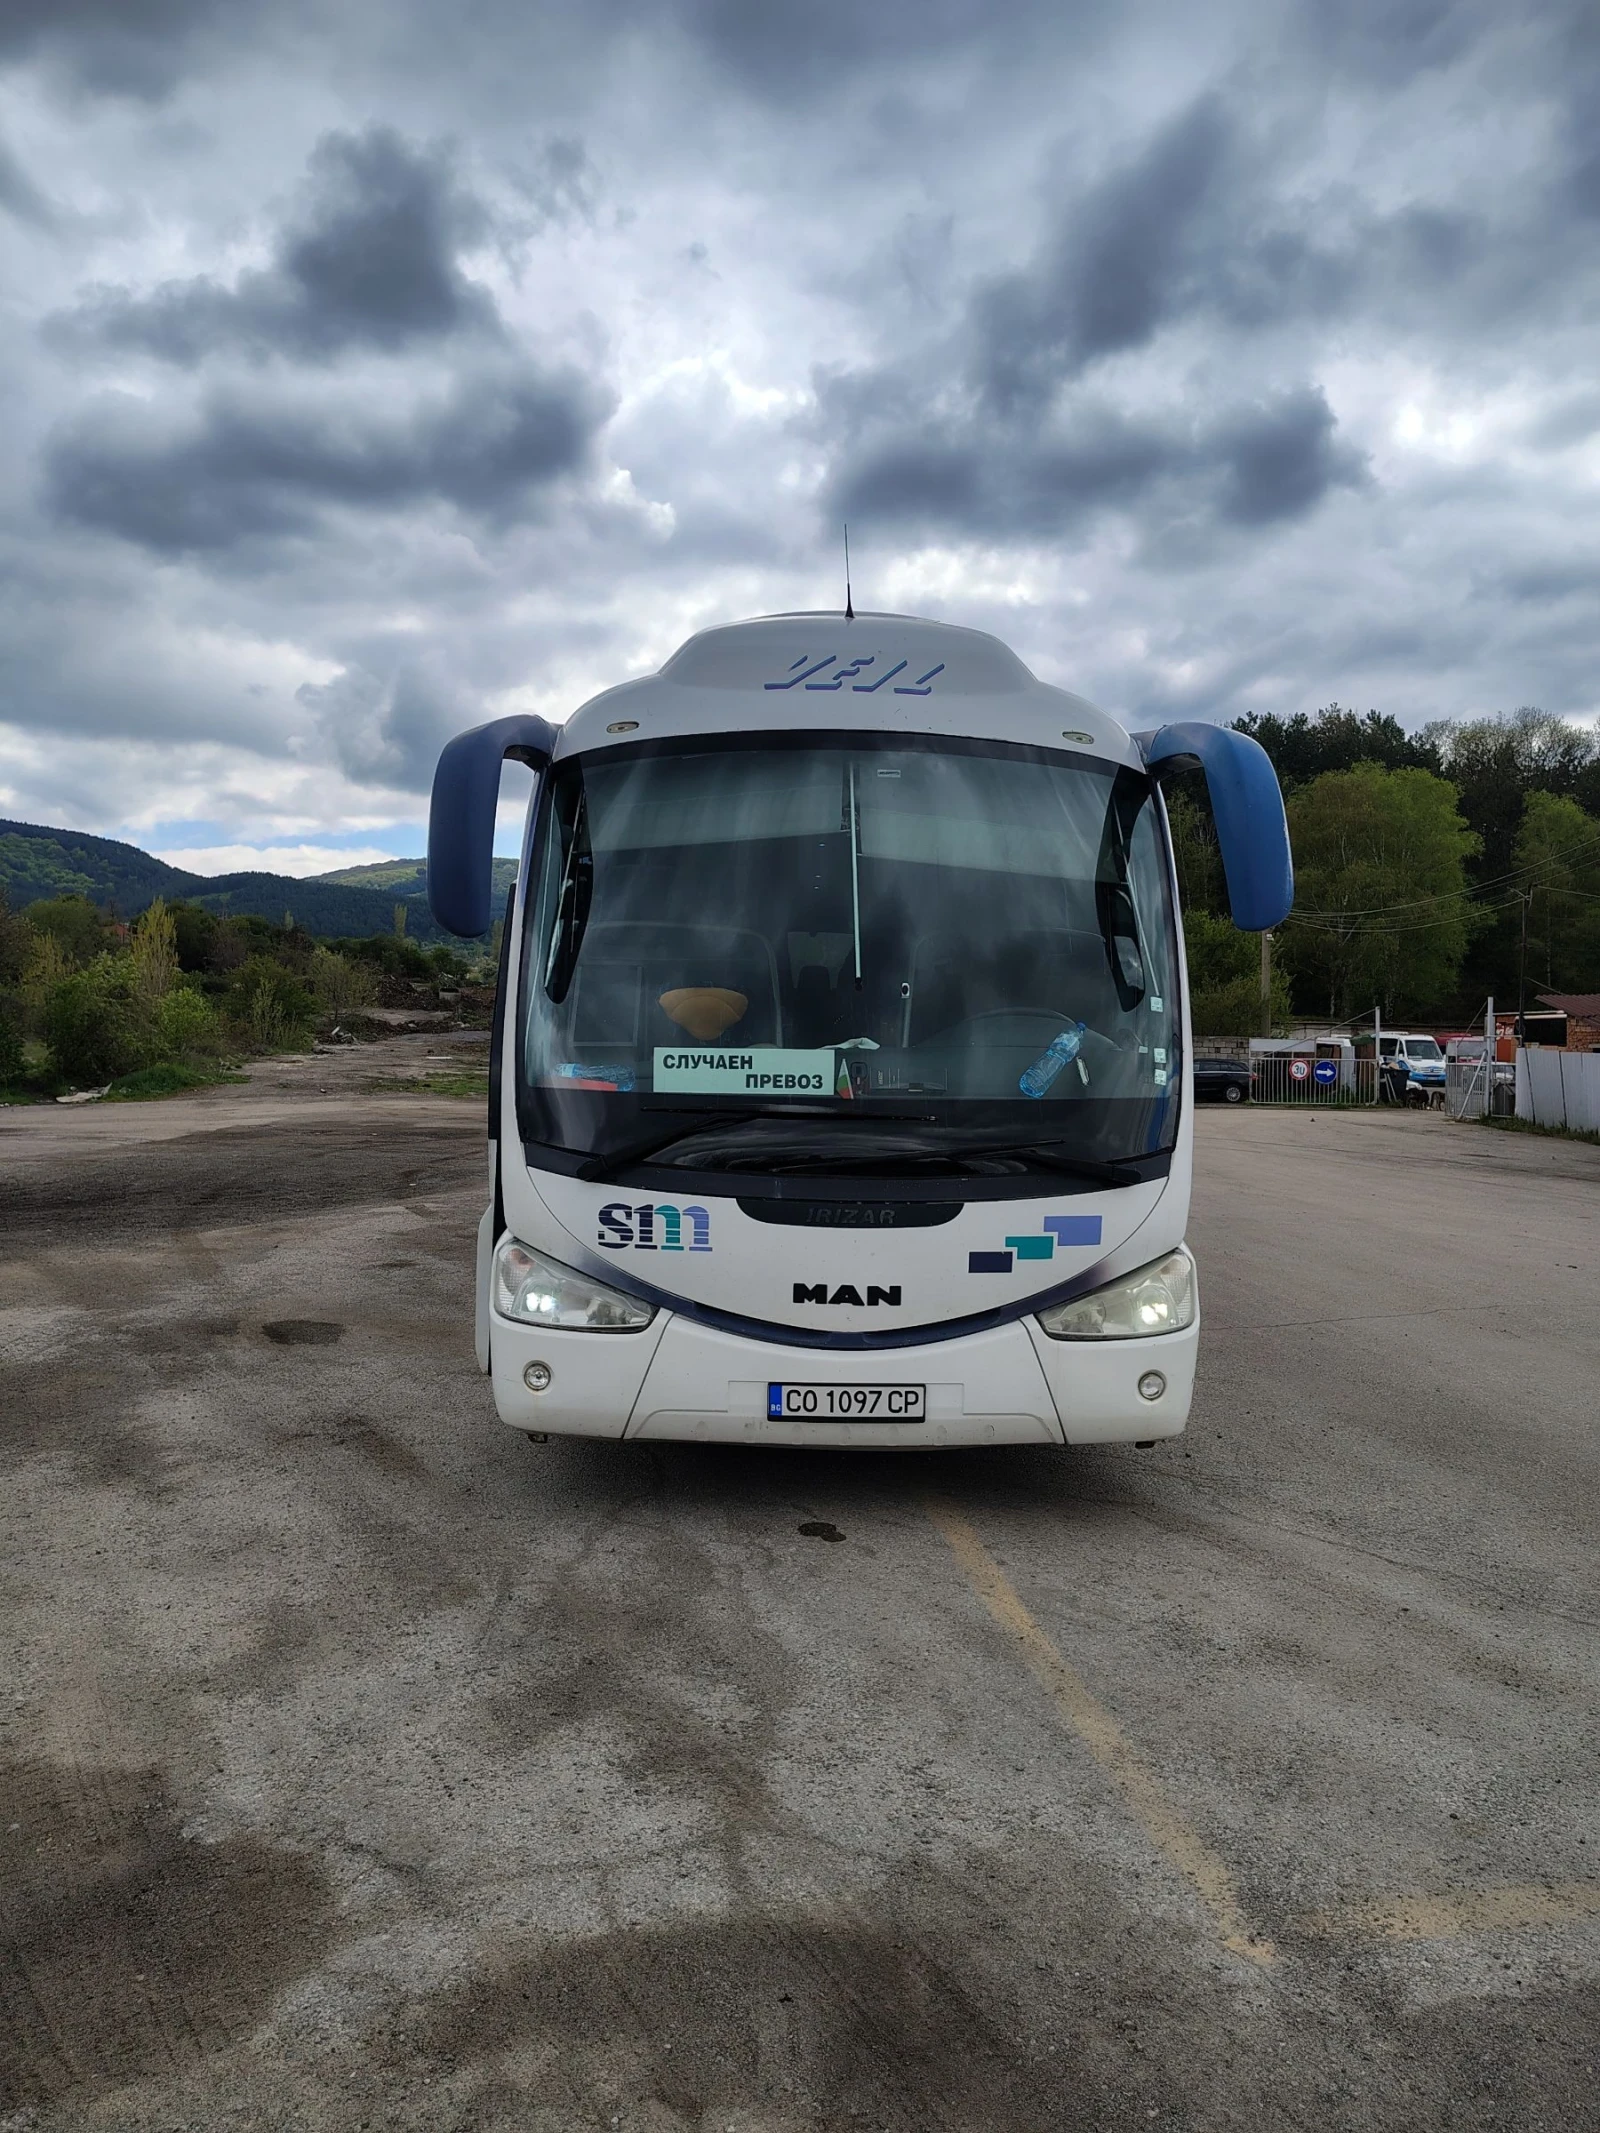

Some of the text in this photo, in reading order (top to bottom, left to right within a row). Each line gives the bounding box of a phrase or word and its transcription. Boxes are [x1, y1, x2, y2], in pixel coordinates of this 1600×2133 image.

[662, 1054, 753, 1070] СЛУЧАЕН
[745, 1074, 823, 1089] ПРЕВОЗ
[806, 1208, 896, 1224] IRIZAR
[793, 1283, 902, 1306] MAN
[786, 1389, 818, 1412] CO
[826, 1390, 882, 1413] 1097
[888, 1390, 919, 1413] CP
